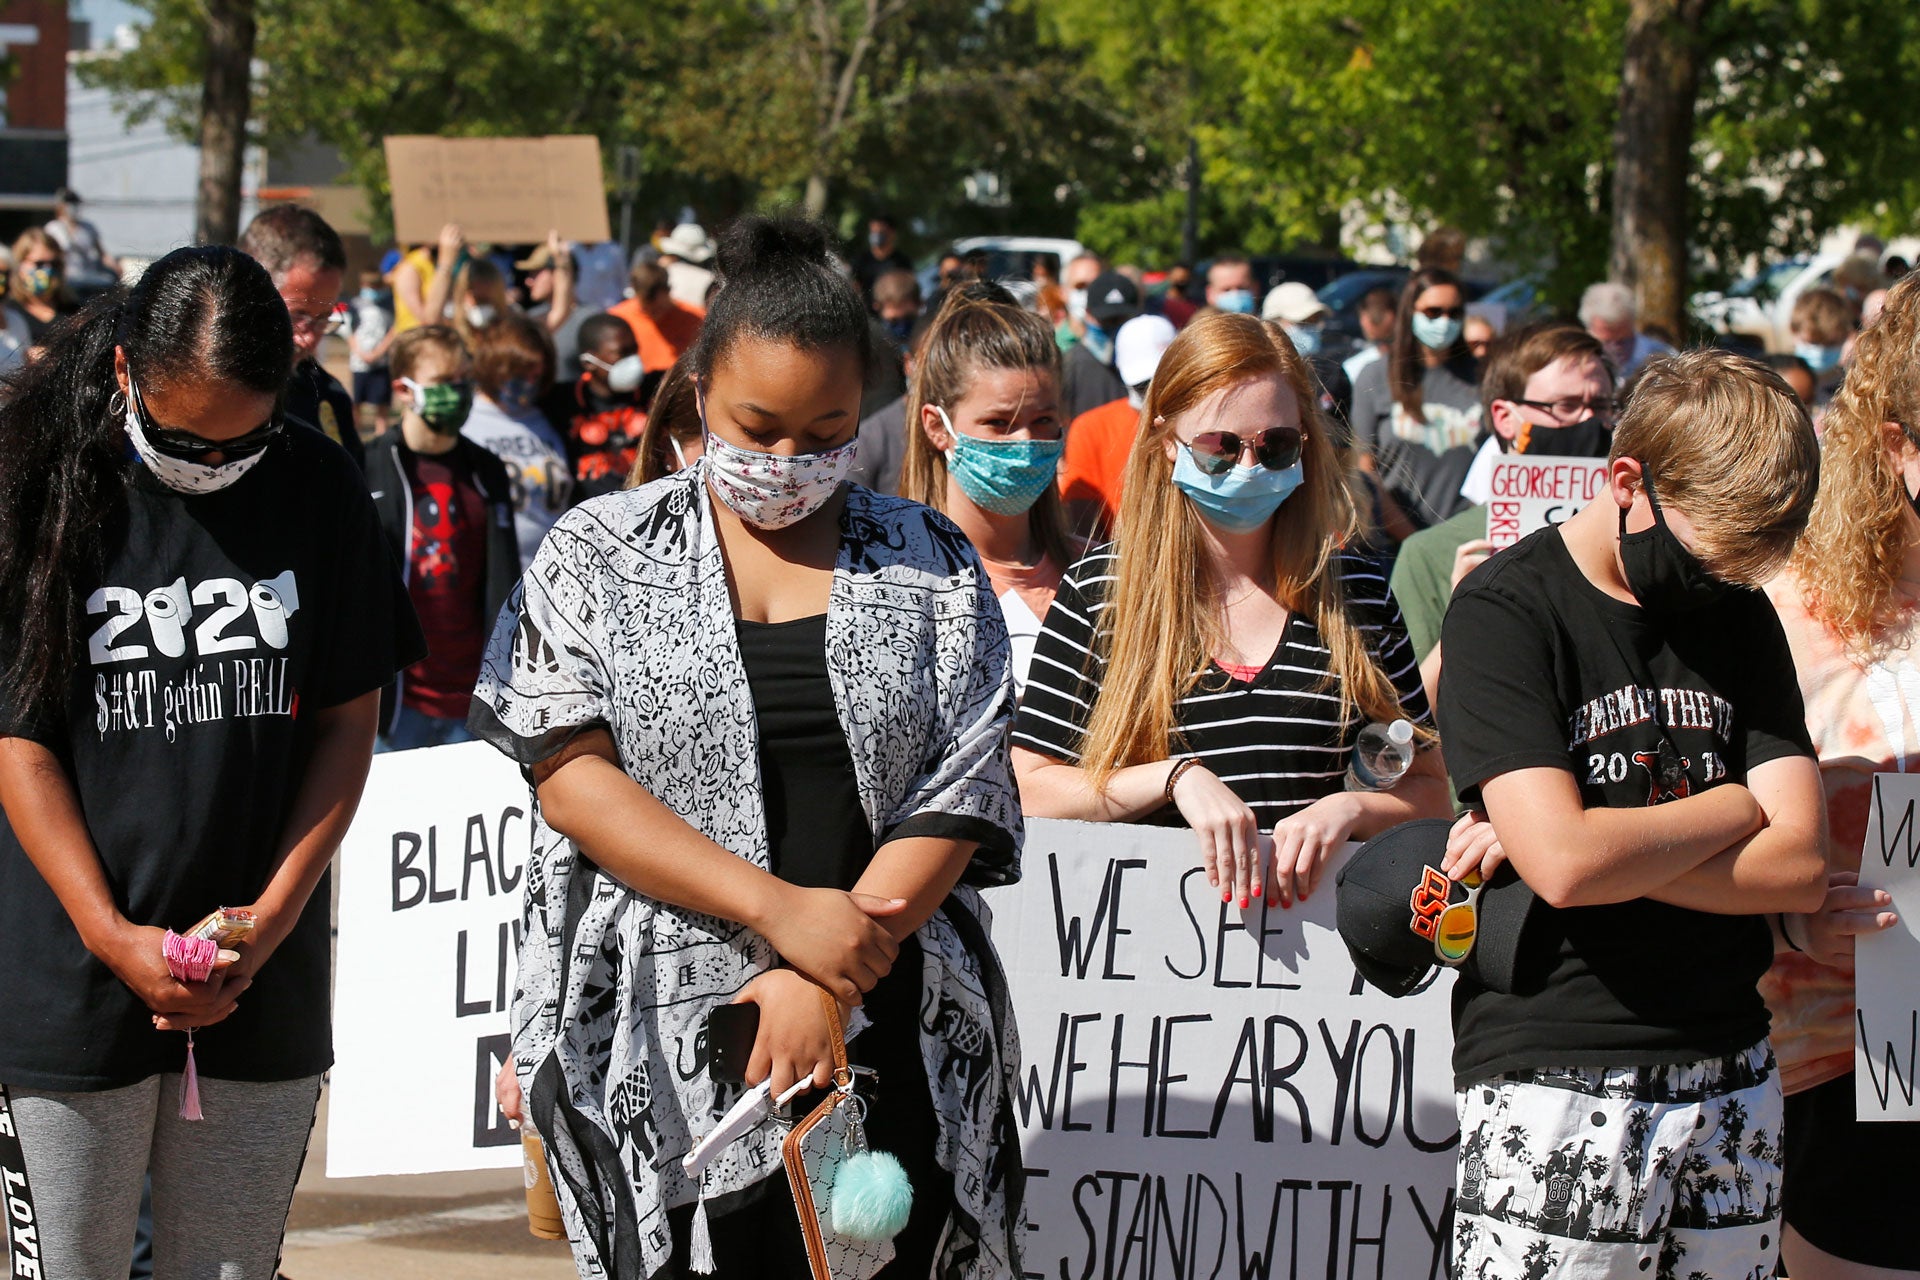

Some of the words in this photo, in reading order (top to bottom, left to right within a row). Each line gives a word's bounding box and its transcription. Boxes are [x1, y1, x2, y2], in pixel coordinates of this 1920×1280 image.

[1490, 502, 1521, 556] BRE
[1569, 466, 1609, 501] FLO
[1660, 687, 1713, 730] THE
[1587, 752, 1628, 785] 20
[392, 806, 538, 912] BLAC
[456, 918, 521, 1018] LI
[1048, 852, 1147, 981] WE
[1164, 866, 1301, 991] SEE
[1016, 1012, 1102, 1132] WE
[1106, 1013, 1313, 1145] HEAR
[1317, 1017, 1460, 1153] YOU
[1060, 1168, 1228, 1280] STAND
